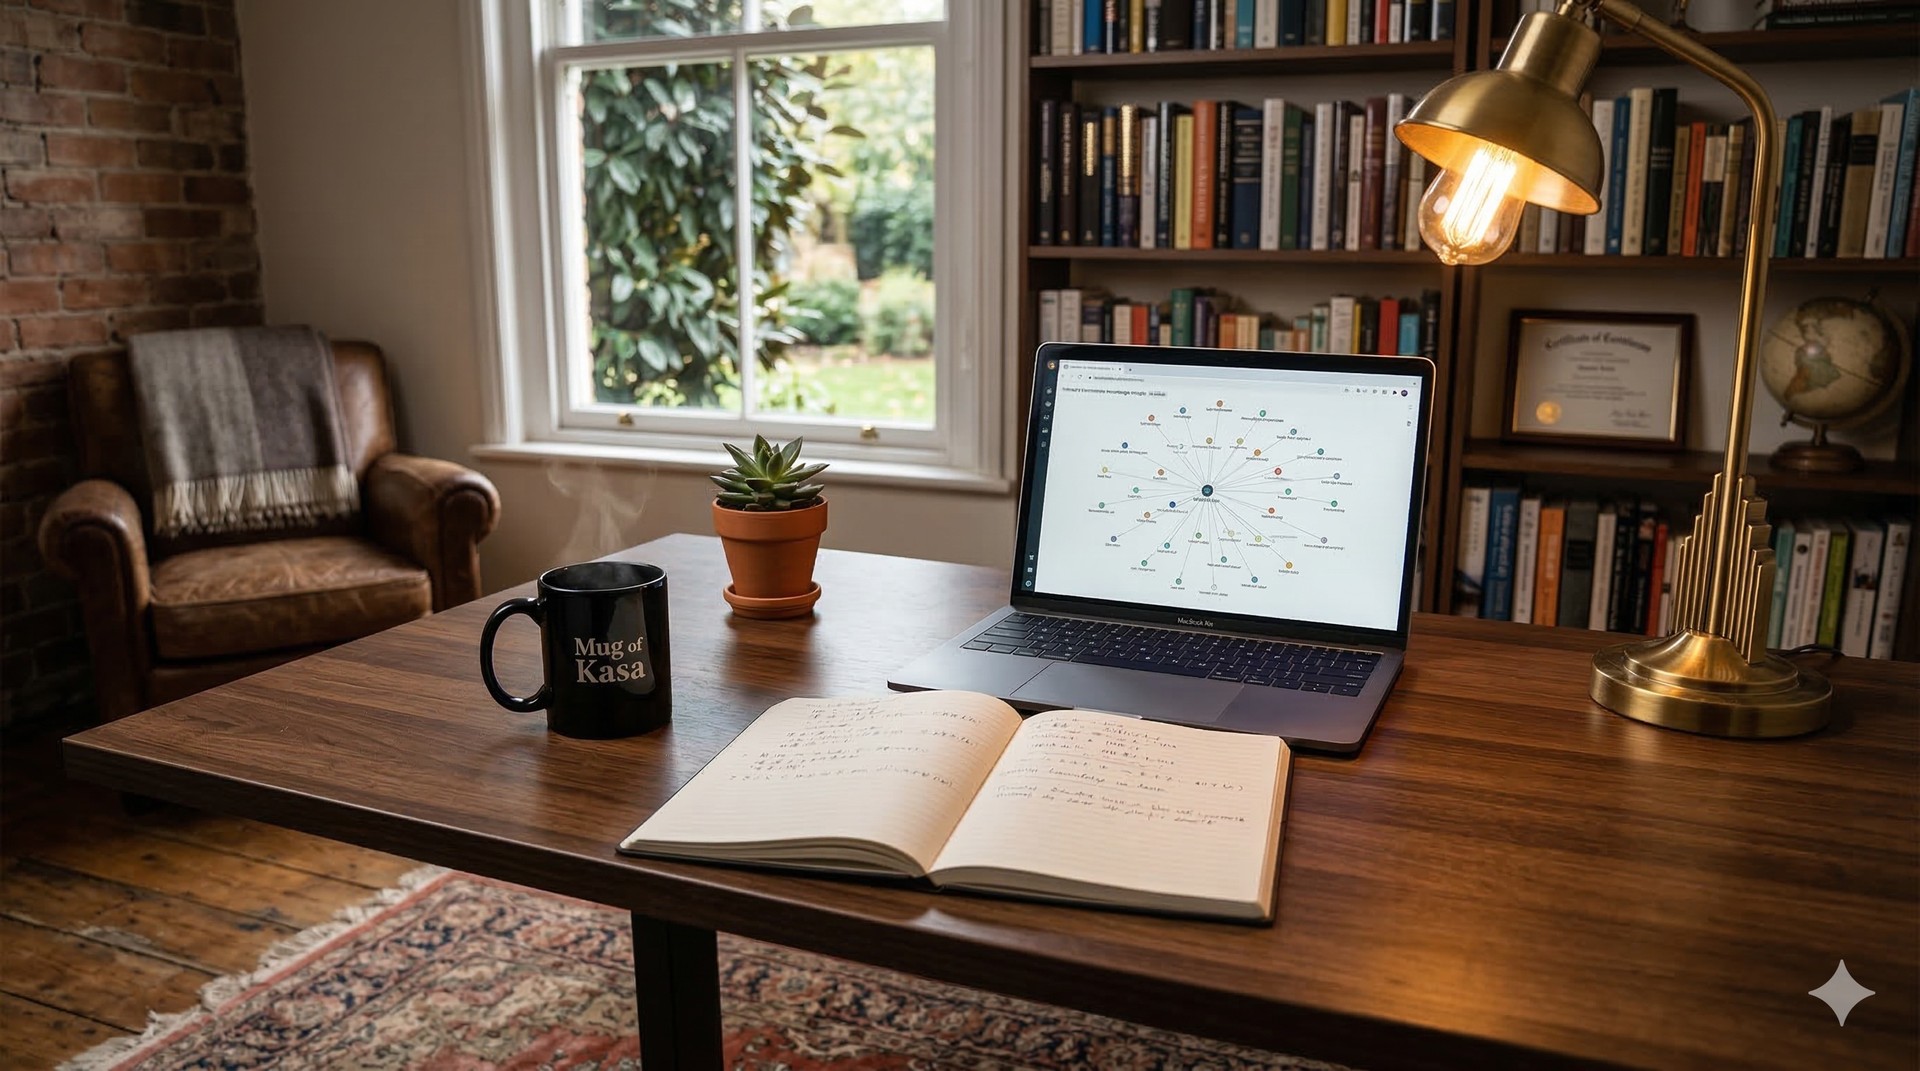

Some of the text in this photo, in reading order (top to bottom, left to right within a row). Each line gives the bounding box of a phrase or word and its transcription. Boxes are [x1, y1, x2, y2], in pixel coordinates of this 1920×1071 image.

[574, 636, 644, 661] Mug of
[575, 659, 647, 684] Kasa
